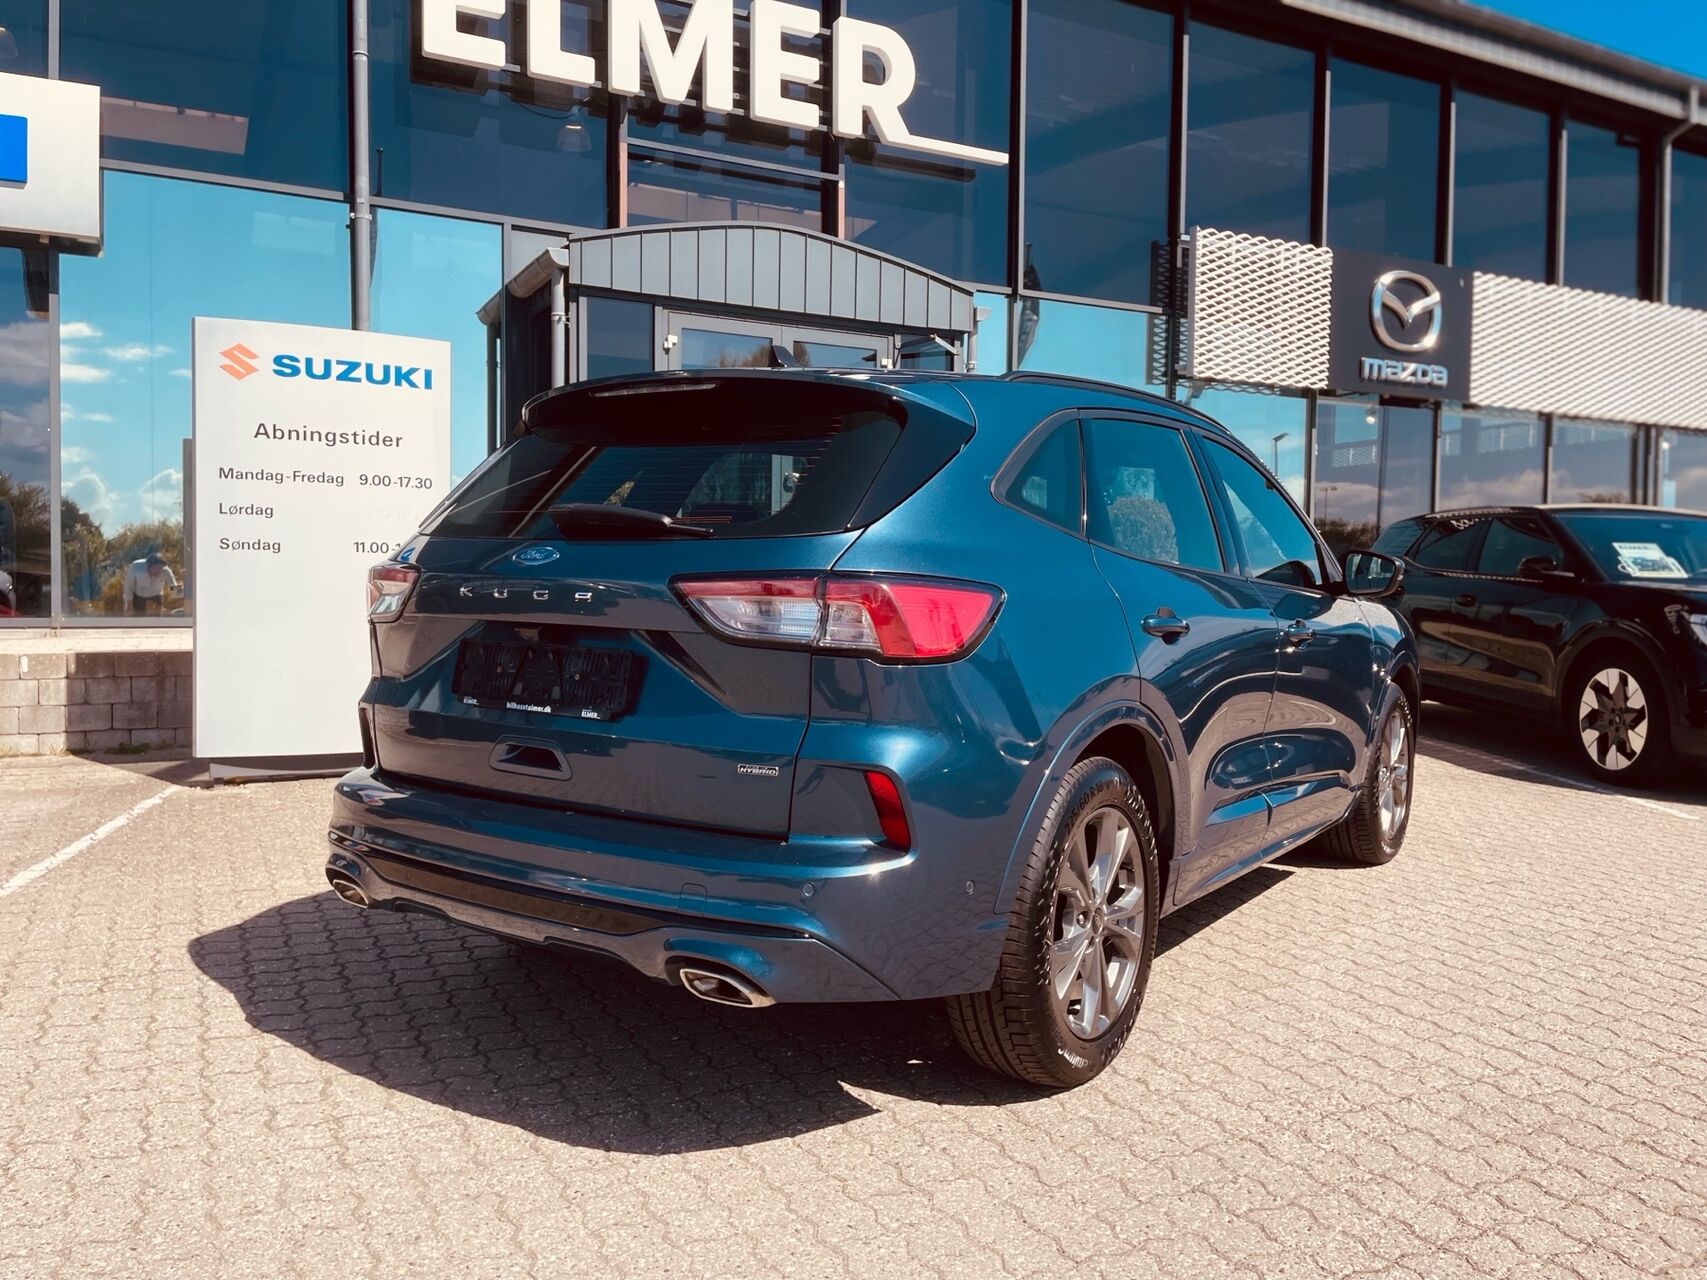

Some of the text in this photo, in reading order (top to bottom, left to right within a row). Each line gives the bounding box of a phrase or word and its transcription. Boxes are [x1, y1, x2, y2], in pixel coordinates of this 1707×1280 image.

[422, 0, 1009, 166] ELMER
[271, 354, 433, 390] SUZUKI
[254, 422, 403, 447] Abningstider
[218, 467, 433, 489] Mandag-Fredag 9.00-17.30
[218, 503, 274, 518] Lørdag
[219, 537, 281, 553] Søndag
[459, 585, 593, 602] KUGA
